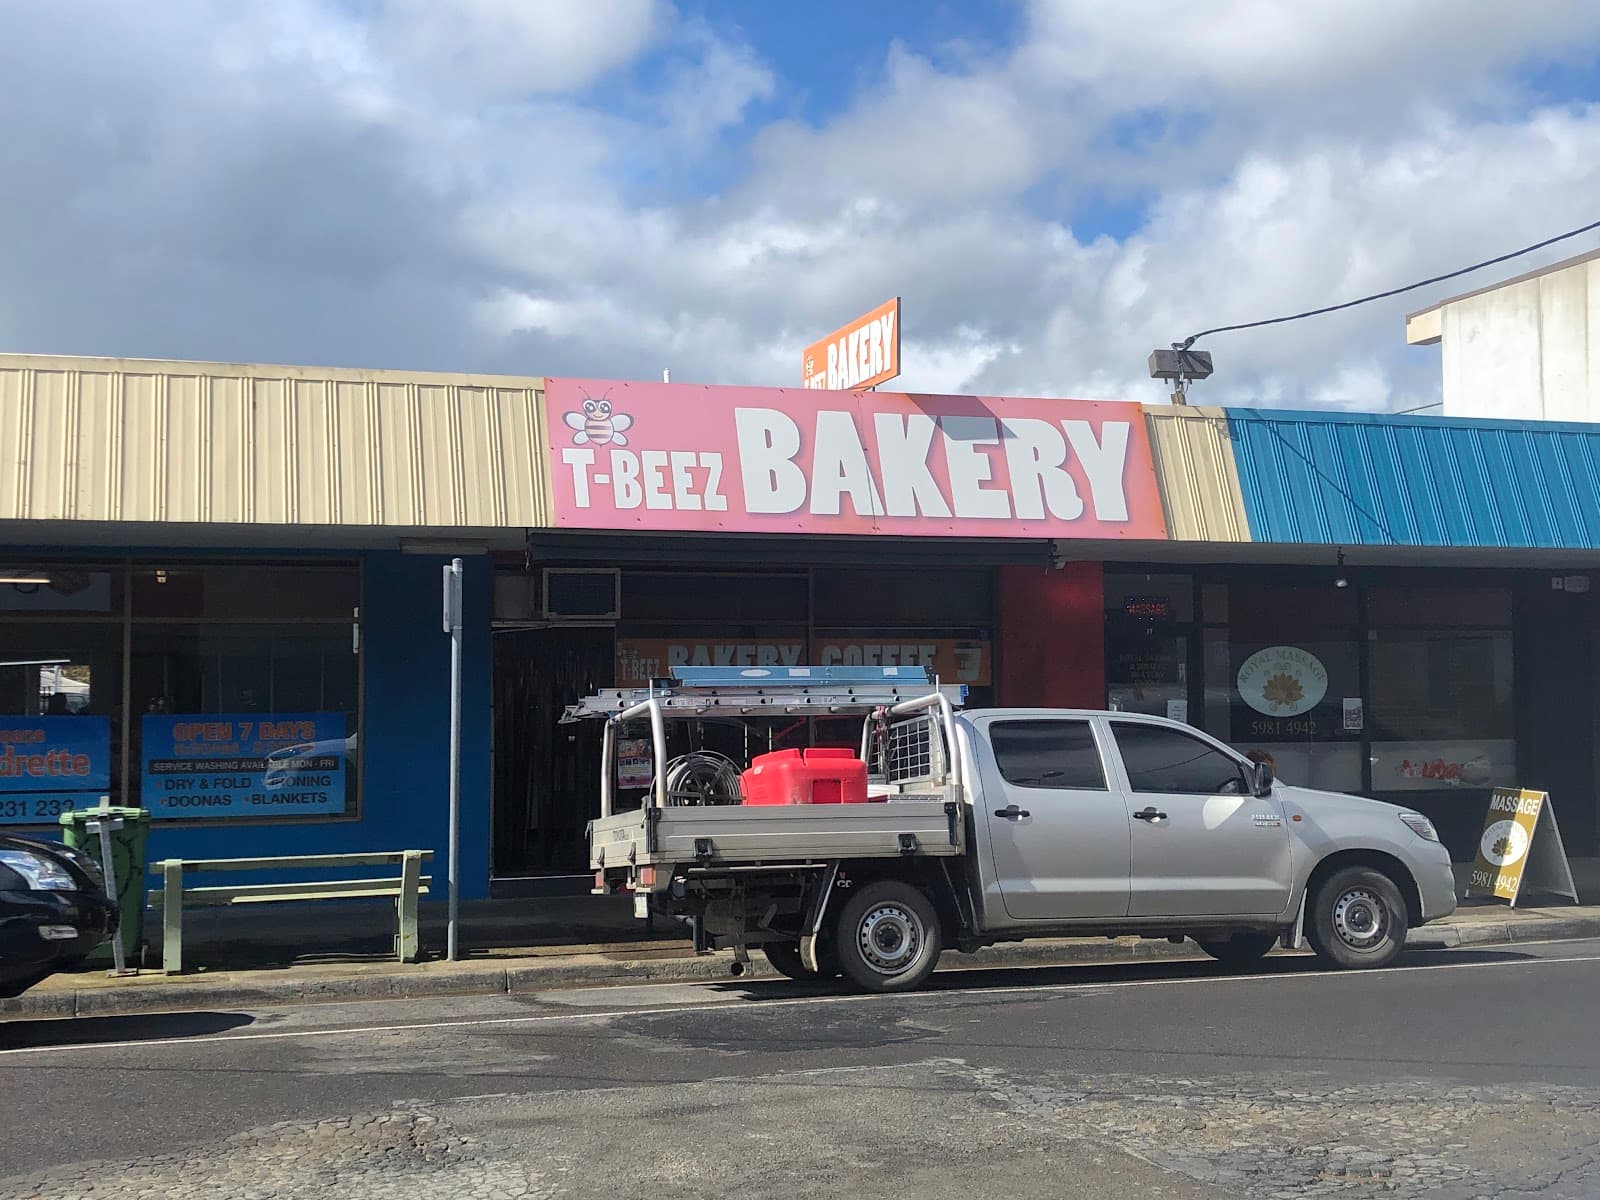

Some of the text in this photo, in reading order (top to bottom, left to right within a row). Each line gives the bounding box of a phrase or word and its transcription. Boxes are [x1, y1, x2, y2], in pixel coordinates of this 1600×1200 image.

[827, 310, 895, 390] BAKERY
[562, 407, 1129, 522] T-BEEZ BAKERY
[174, 720, 316, 742] OPEN 7 DAYS
[153, 761, 193, 772] SERVICE
[195, 760, 238, 771] WASHING
[292, 759, 313, 769] MON
[320, 759, 335, 768] FRI
[165, 776, 331, 790] DRY & FOLD ONING
[168, 792, 328, 807] DOONAS BLANKETS
[1490, 795, 1539, 815] MASSAGE
[1470, 870, 1518, 893] 5981 4942
